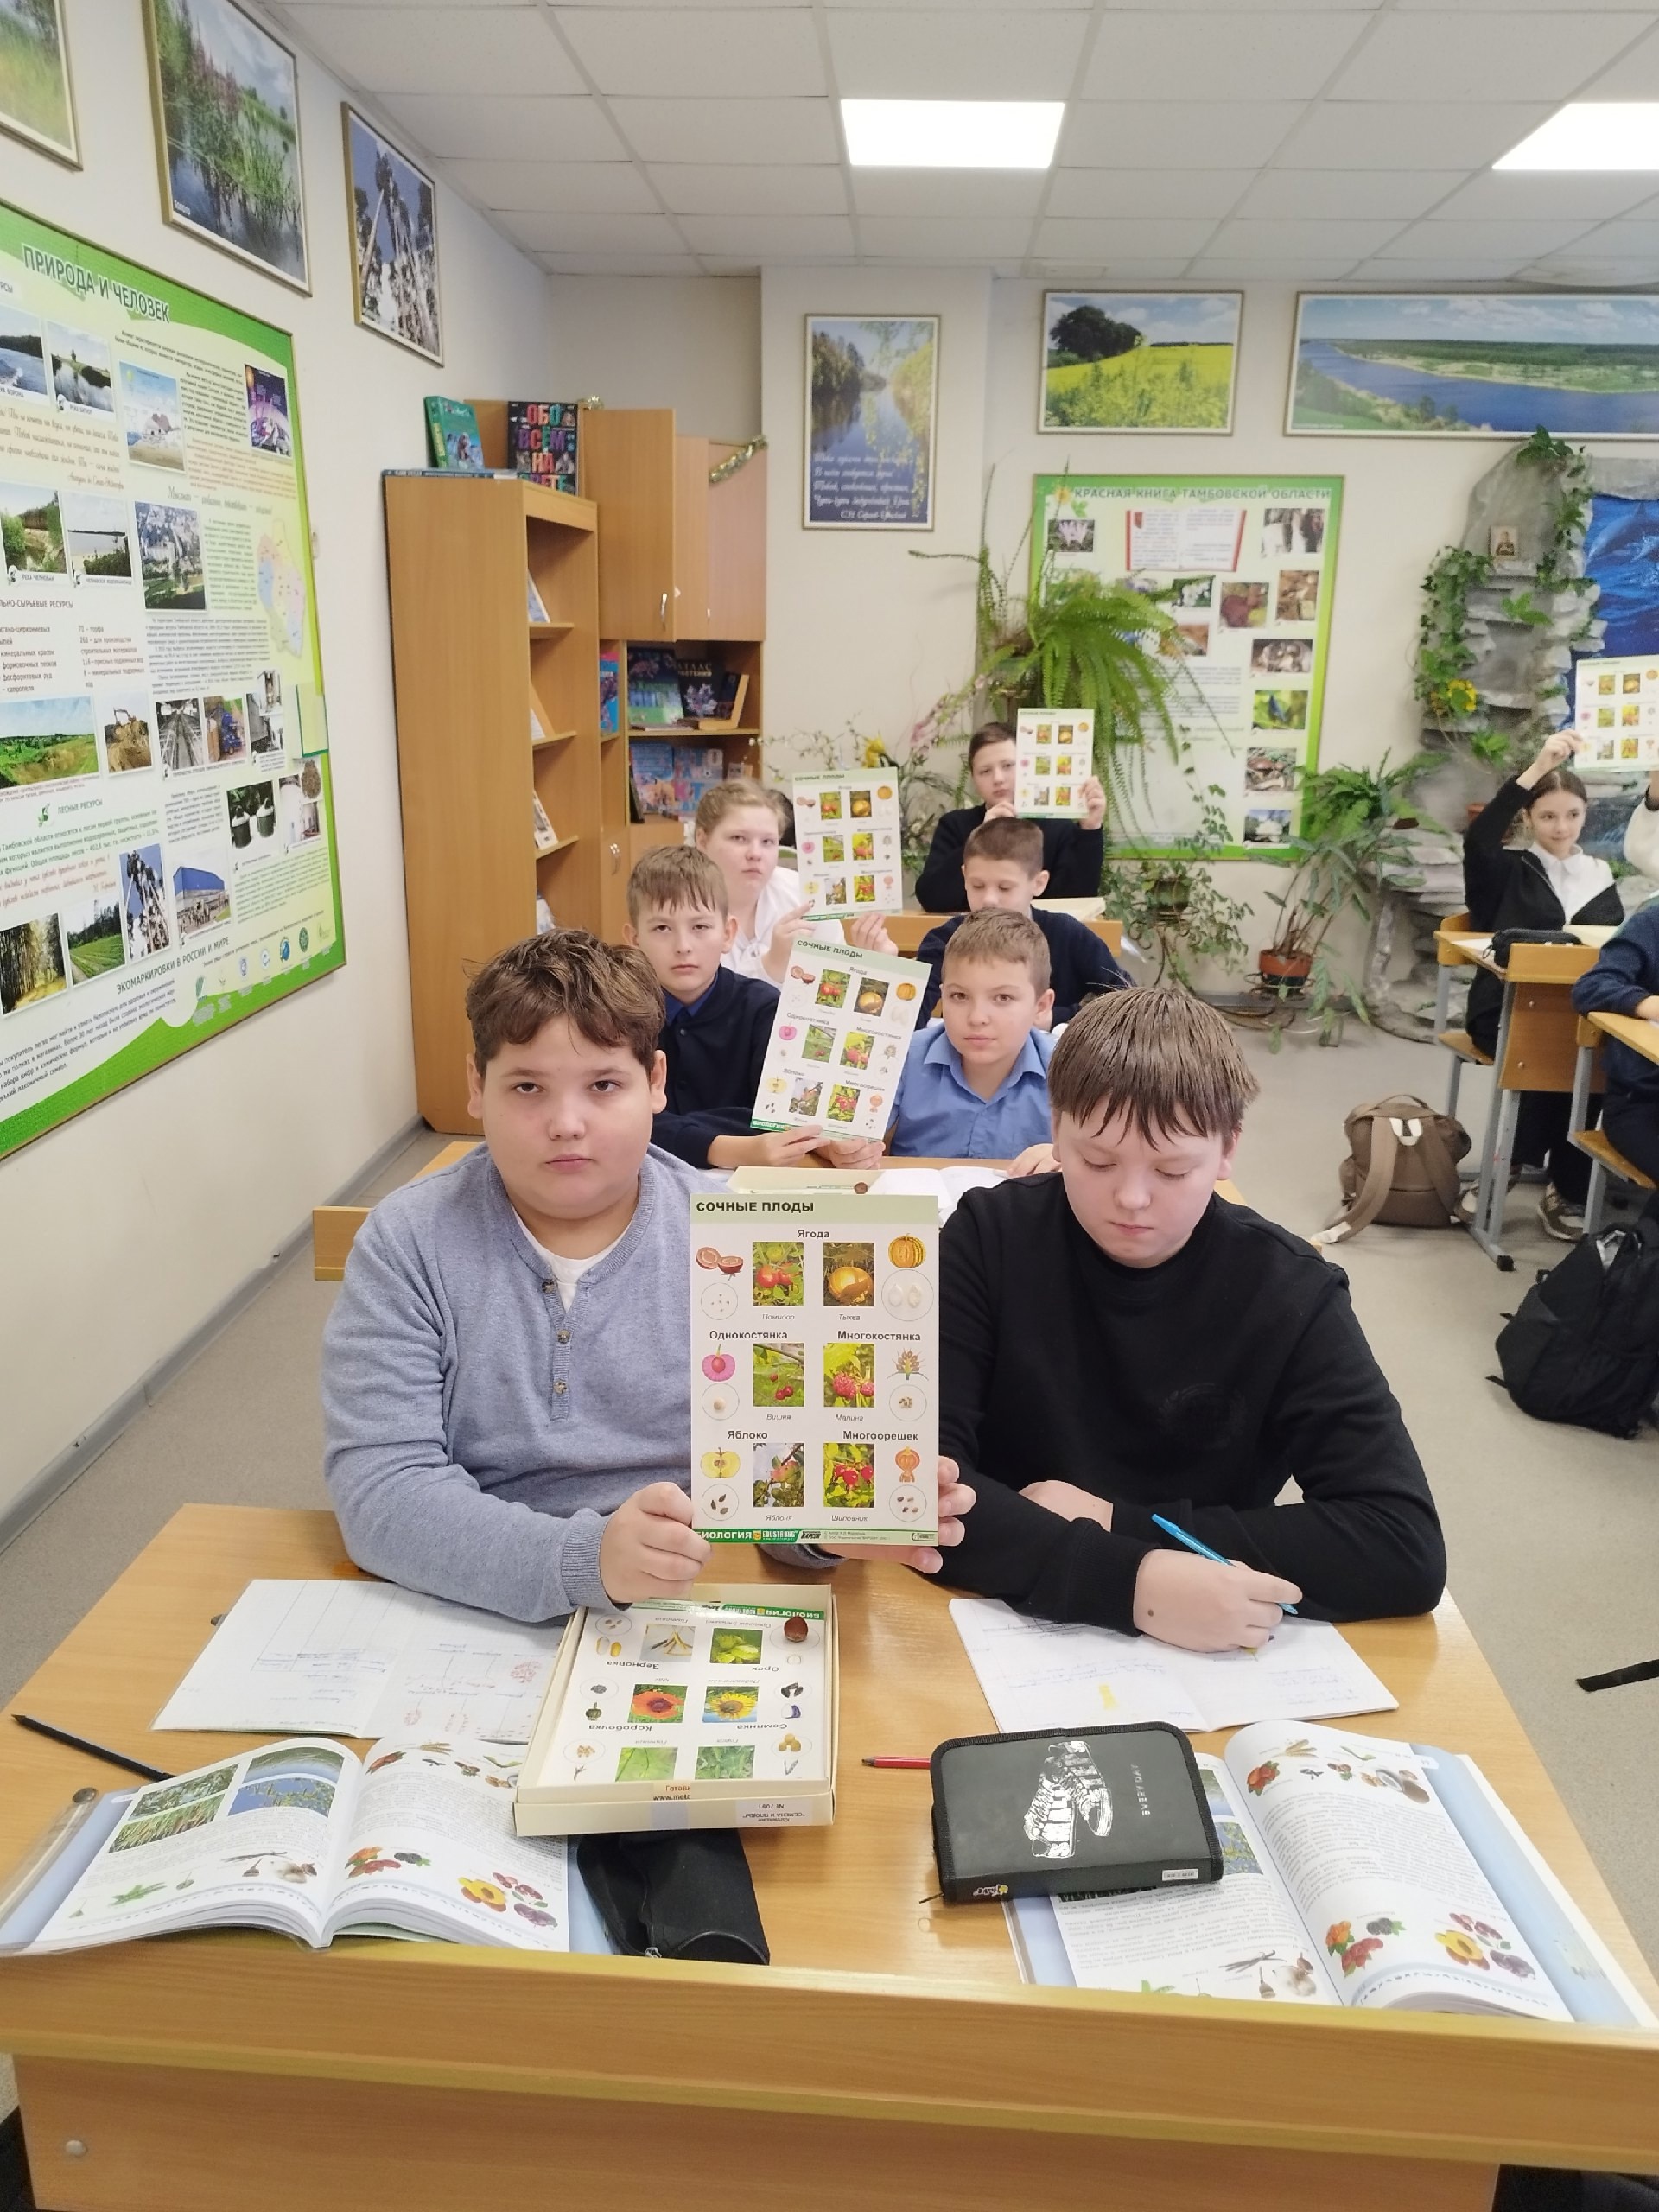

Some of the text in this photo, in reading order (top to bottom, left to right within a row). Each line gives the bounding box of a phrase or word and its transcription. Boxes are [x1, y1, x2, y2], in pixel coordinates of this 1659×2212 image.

[22, 245, 169, 322] ПРИРОДА И ЧЕЛОВЕК
[527, 404, 561, 426] ОБО
[531, 452, 555, 474] НА
[1074, 486, 1331, 499] КРАСНАЯ КНИГА ТАМБОВСКОЙ ОБЛАСТИ
[49, 600, 73, 608] РЕСУРСЫ
[797, 939, 862, 959] СОЧНЫЕ ПЛОДЫ
[116, 937, 229, 995] ЭКОМАРКИРОВКИ В РОССИИ И МИРЕ
[696, 1201, 814, 1213] СОЧНЫЕ ПЛОДЫ
[797, 1229, 830, 1240] Ягода
[761, 1313, 795, 1322] Помидор
[838, 1313, 861, 1322] Тыква
[709, 1330, 788, 1340] Однокостянка
[837, 1330, 921, 1342] Многокостянка
[766, 1413, 791, 1421] Вишня
[727, 1429, 768, 1440] Яблоко
[842, 1430, 918, 1441] Многоорешек
[765, 1514, 792, 1522] Яблоня
[831, 1514, 868, 1522] Шиповник
[764, 1609, 820, 1620] БИОЛОГИЯ
[607, 1660, 659, 1669] Зерновка
[1136, 1784, 1151, 1815] EVERY
